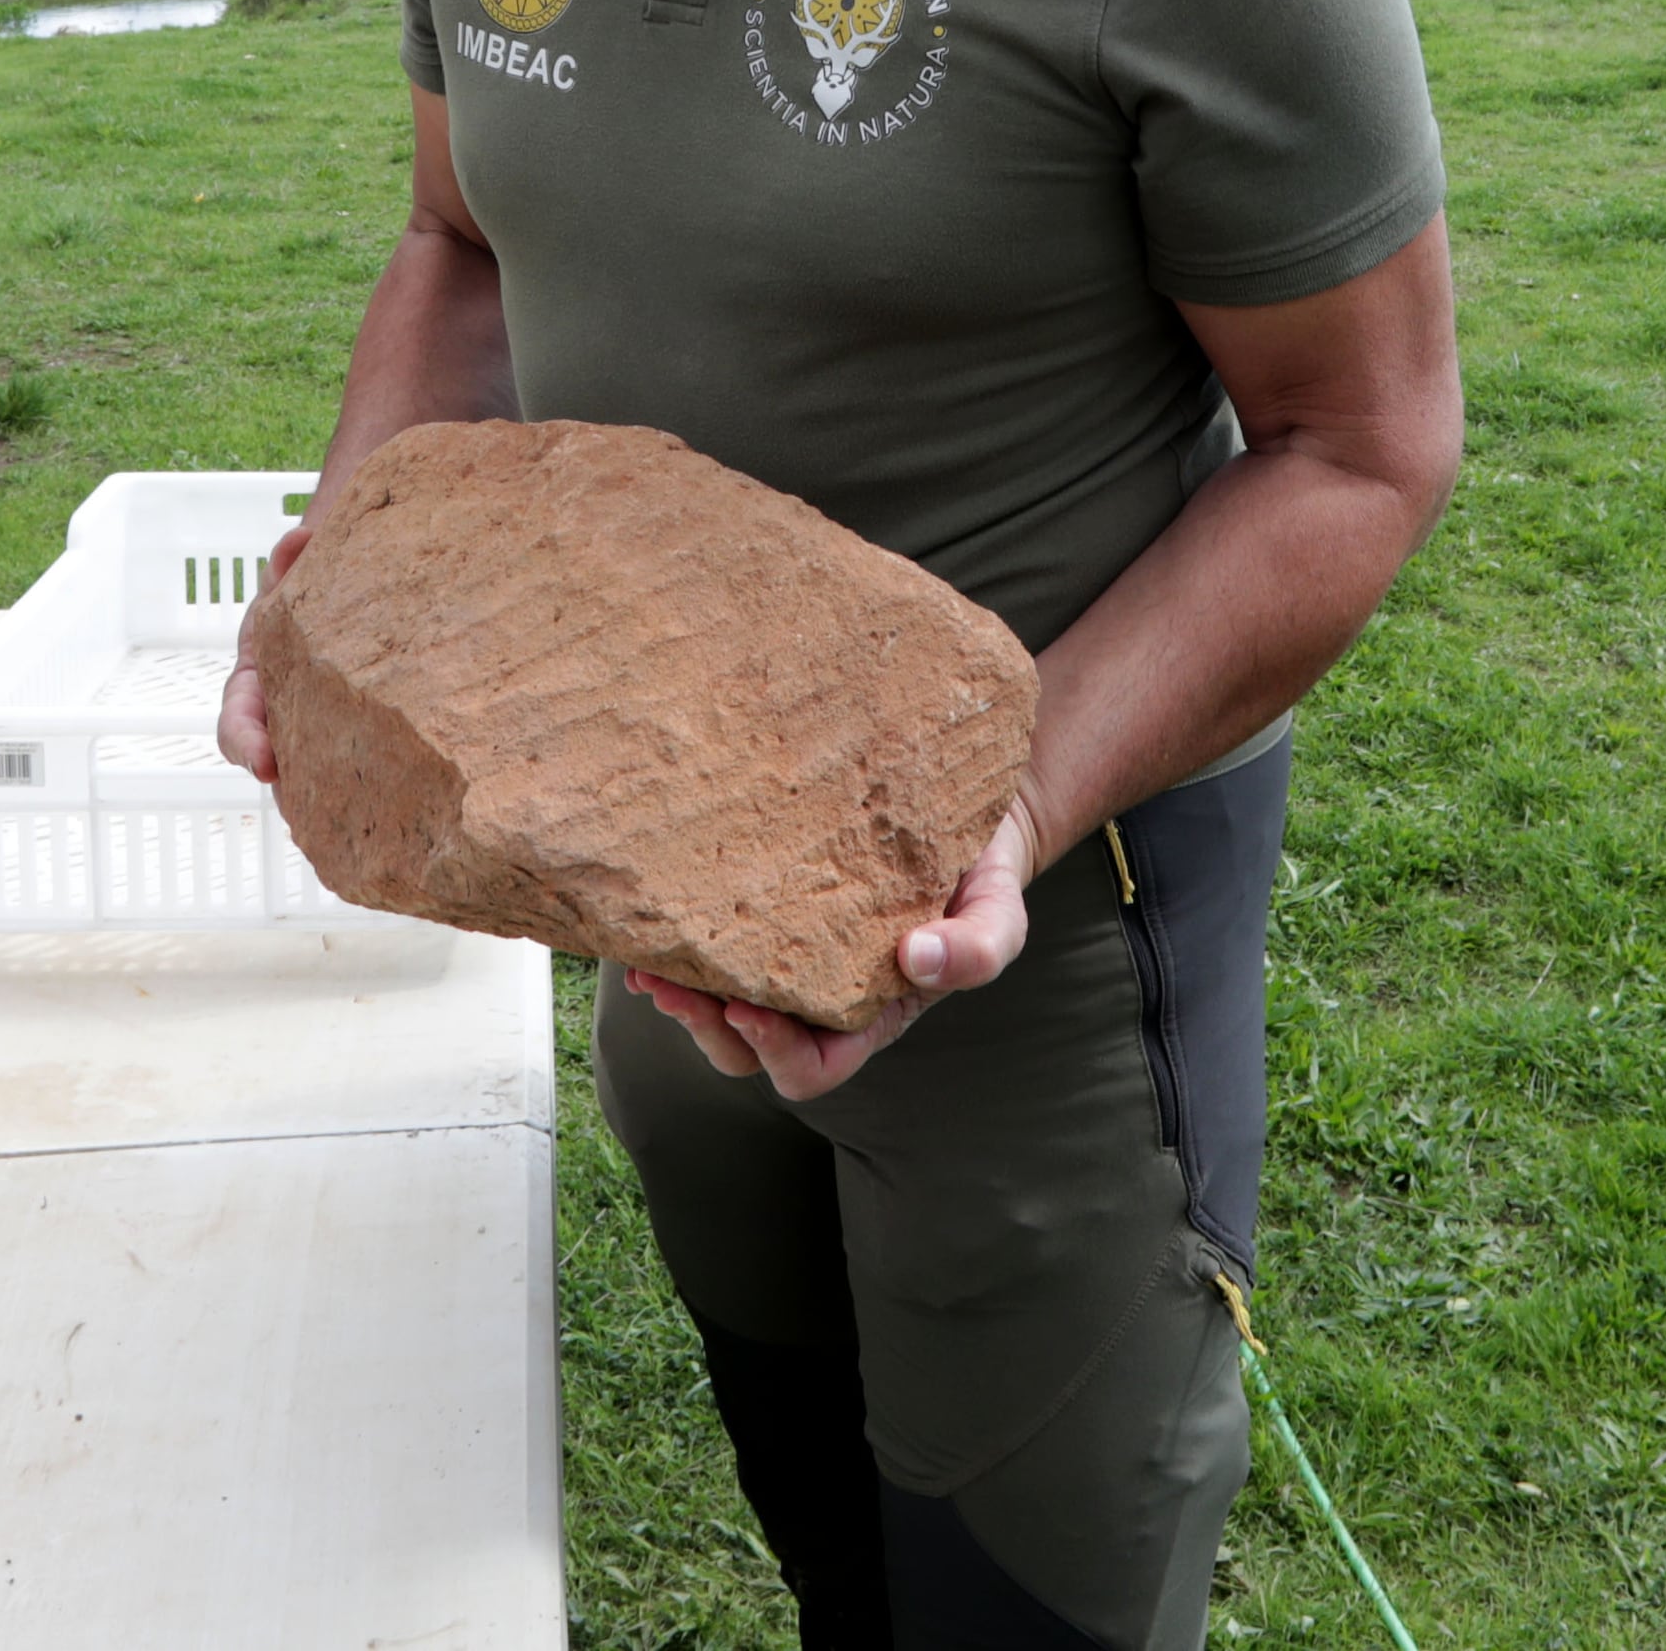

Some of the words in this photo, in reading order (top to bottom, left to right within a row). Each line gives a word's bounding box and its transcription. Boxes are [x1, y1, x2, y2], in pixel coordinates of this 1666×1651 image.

[457, 21, 577, 90] IMBEAC
[744, 9, 808, 135] SCIENTIA
[816, 121, 847, 144] IN
[859, 46, 948, 142] NATURA
